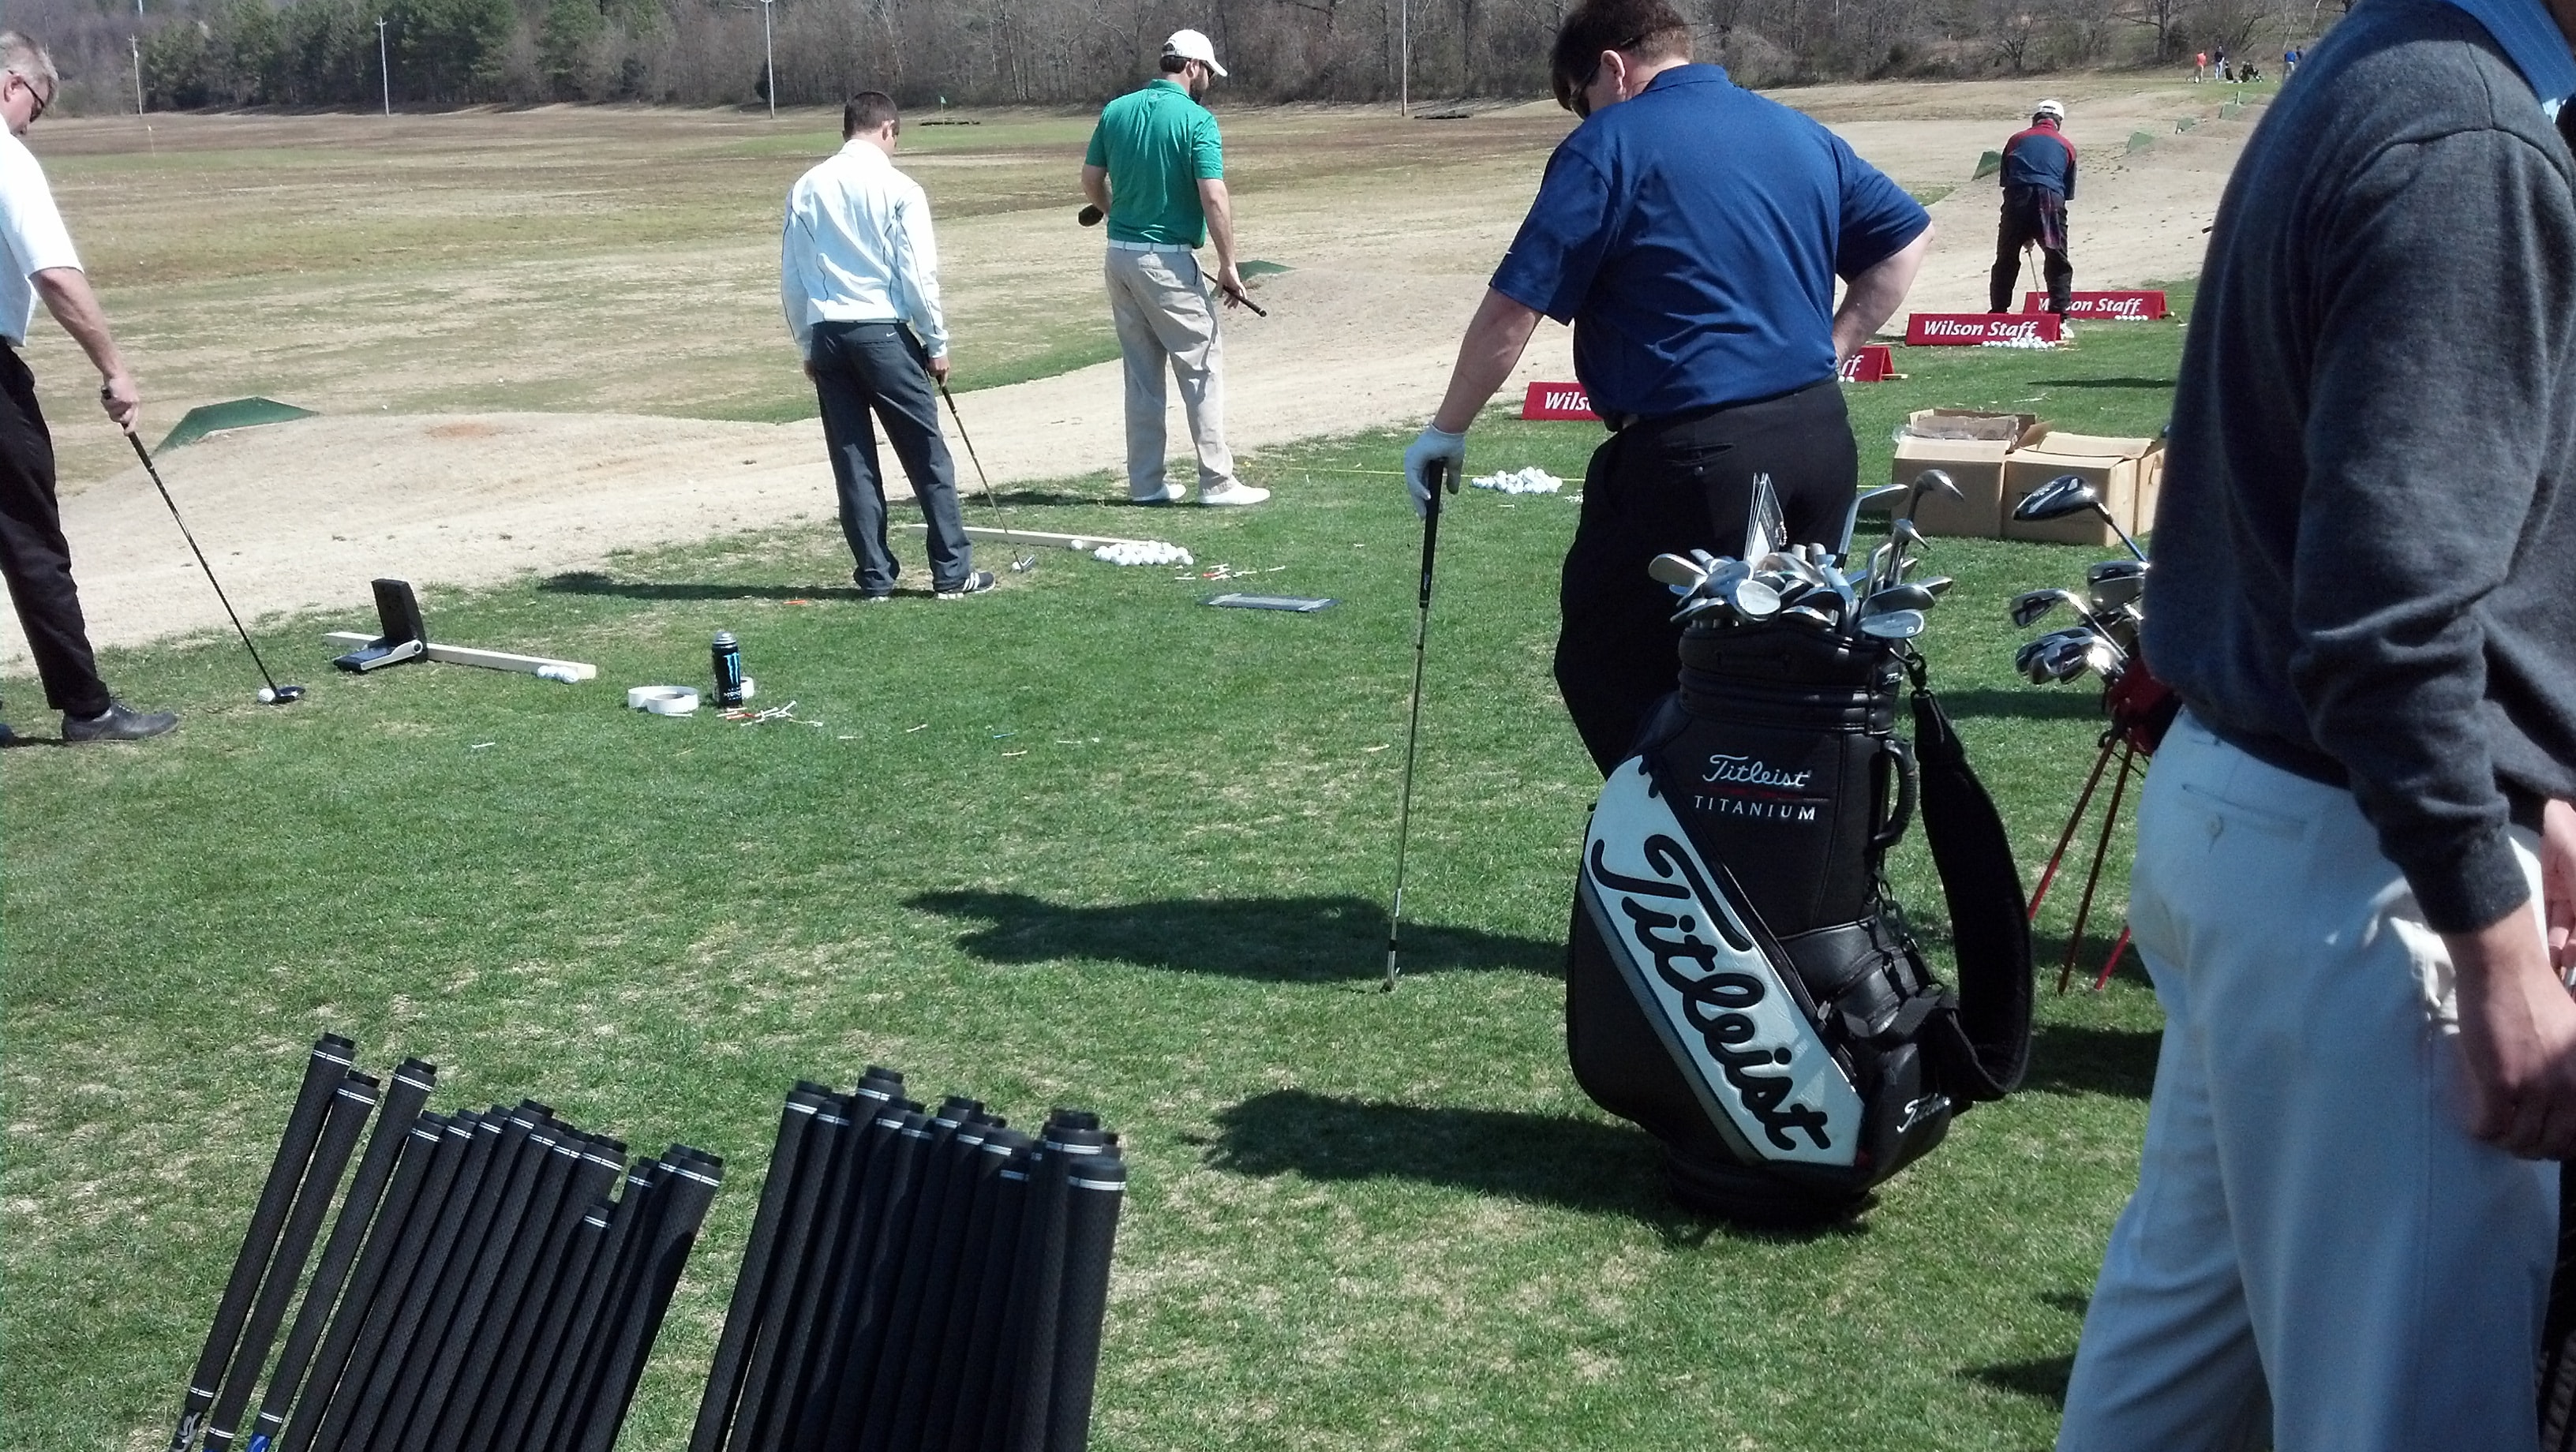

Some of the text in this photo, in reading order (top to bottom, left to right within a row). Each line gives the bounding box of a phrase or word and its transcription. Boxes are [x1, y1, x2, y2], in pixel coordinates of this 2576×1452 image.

[2038, 298, 2144, 316] Won Staff
[1923, 320, 2039, 339] Wilson Staff
[1544, 391, 1592, 411] Wils
[1702, 754, 1811, 788] Titleist
[1694, 795, 1816, 821] TITANIUM
[1590, 833, 1833, 1152] Titleist
